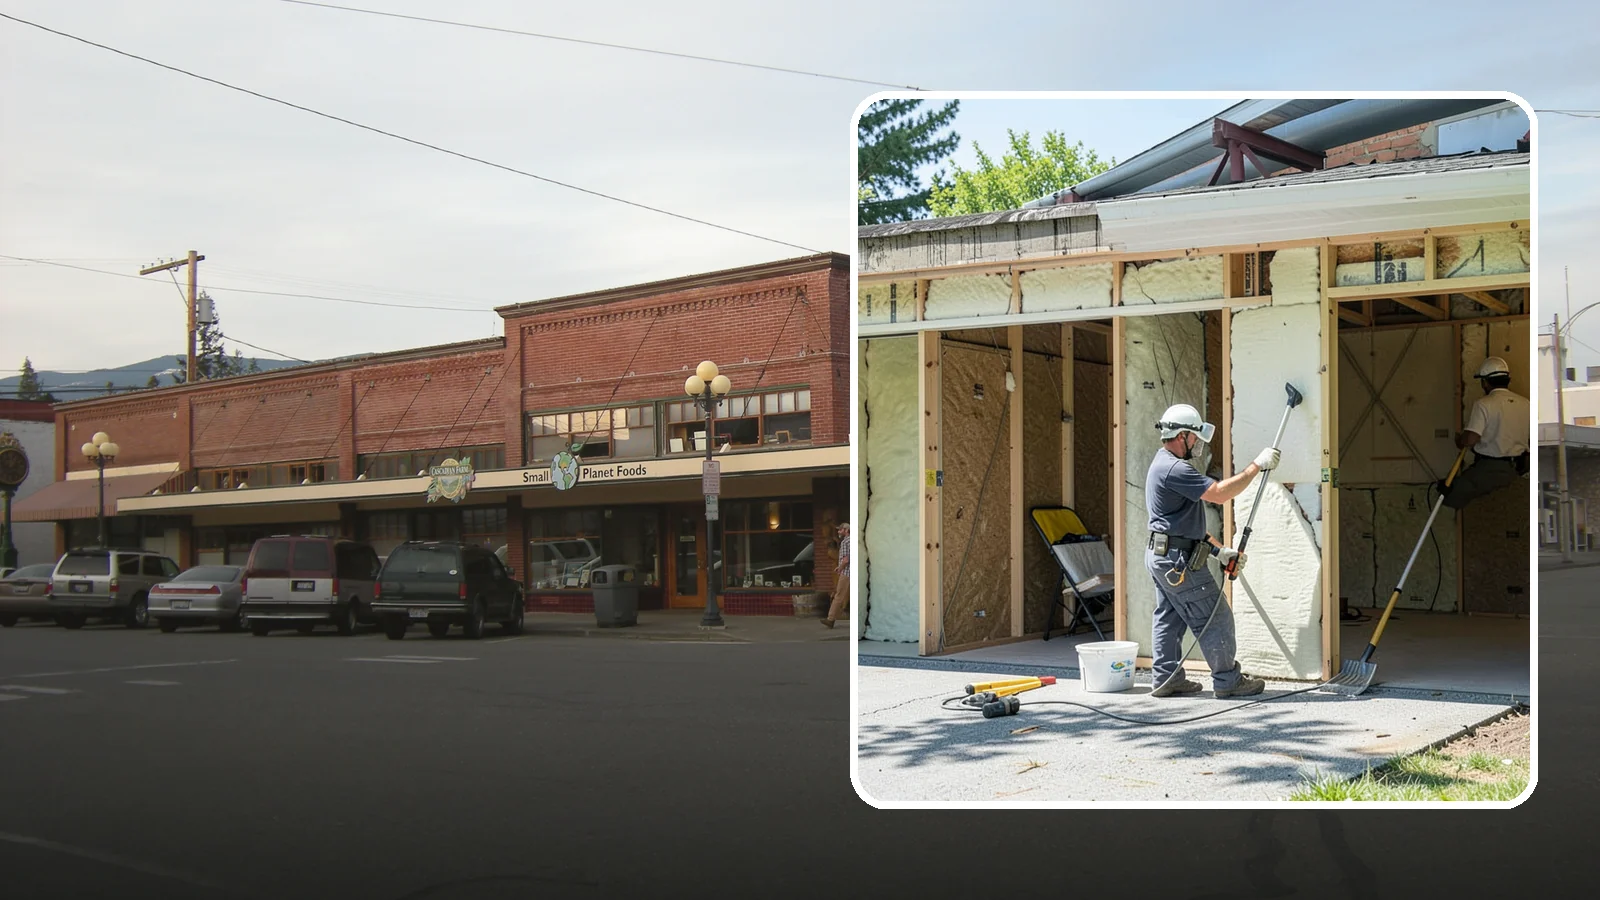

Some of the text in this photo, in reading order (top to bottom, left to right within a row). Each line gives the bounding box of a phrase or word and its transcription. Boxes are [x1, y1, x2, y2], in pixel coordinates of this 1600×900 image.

[523, 464, 647, 483] Small Planet Foods
